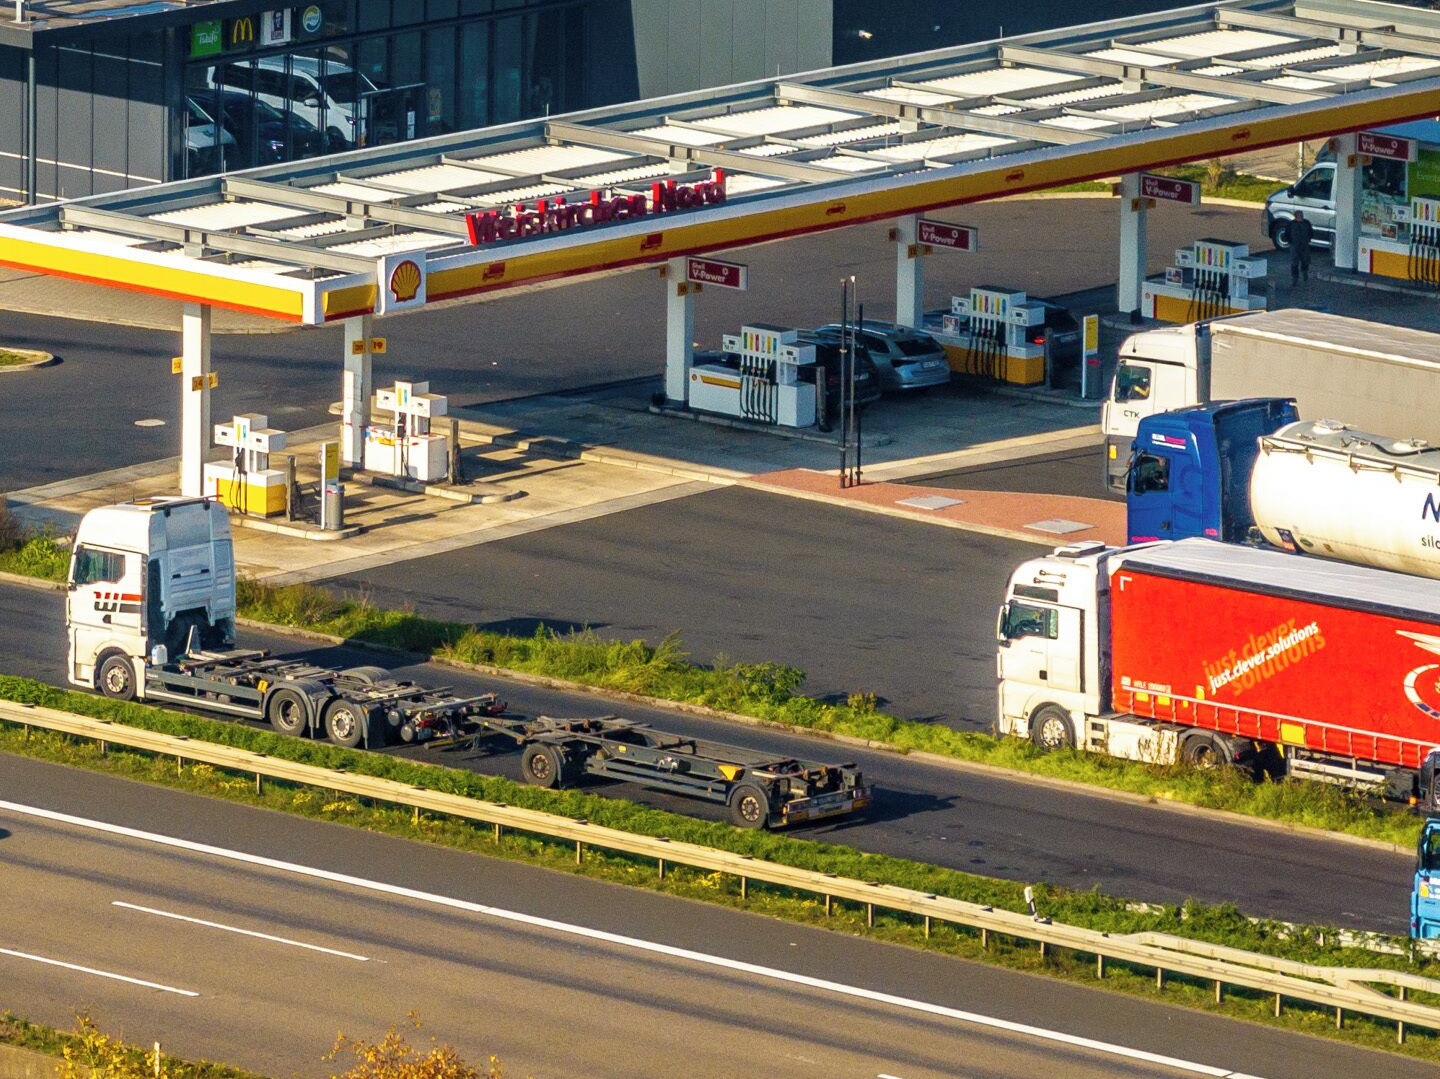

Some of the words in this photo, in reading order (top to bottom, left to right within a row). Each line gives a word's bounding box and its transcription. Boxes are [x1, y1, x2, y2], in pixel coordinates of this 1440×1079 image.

[691, 268, 726, 283] V-Power
[1123, 409, 1141, 419] CTK
[1209, 621, 1320, 695] just.clever.solutions
